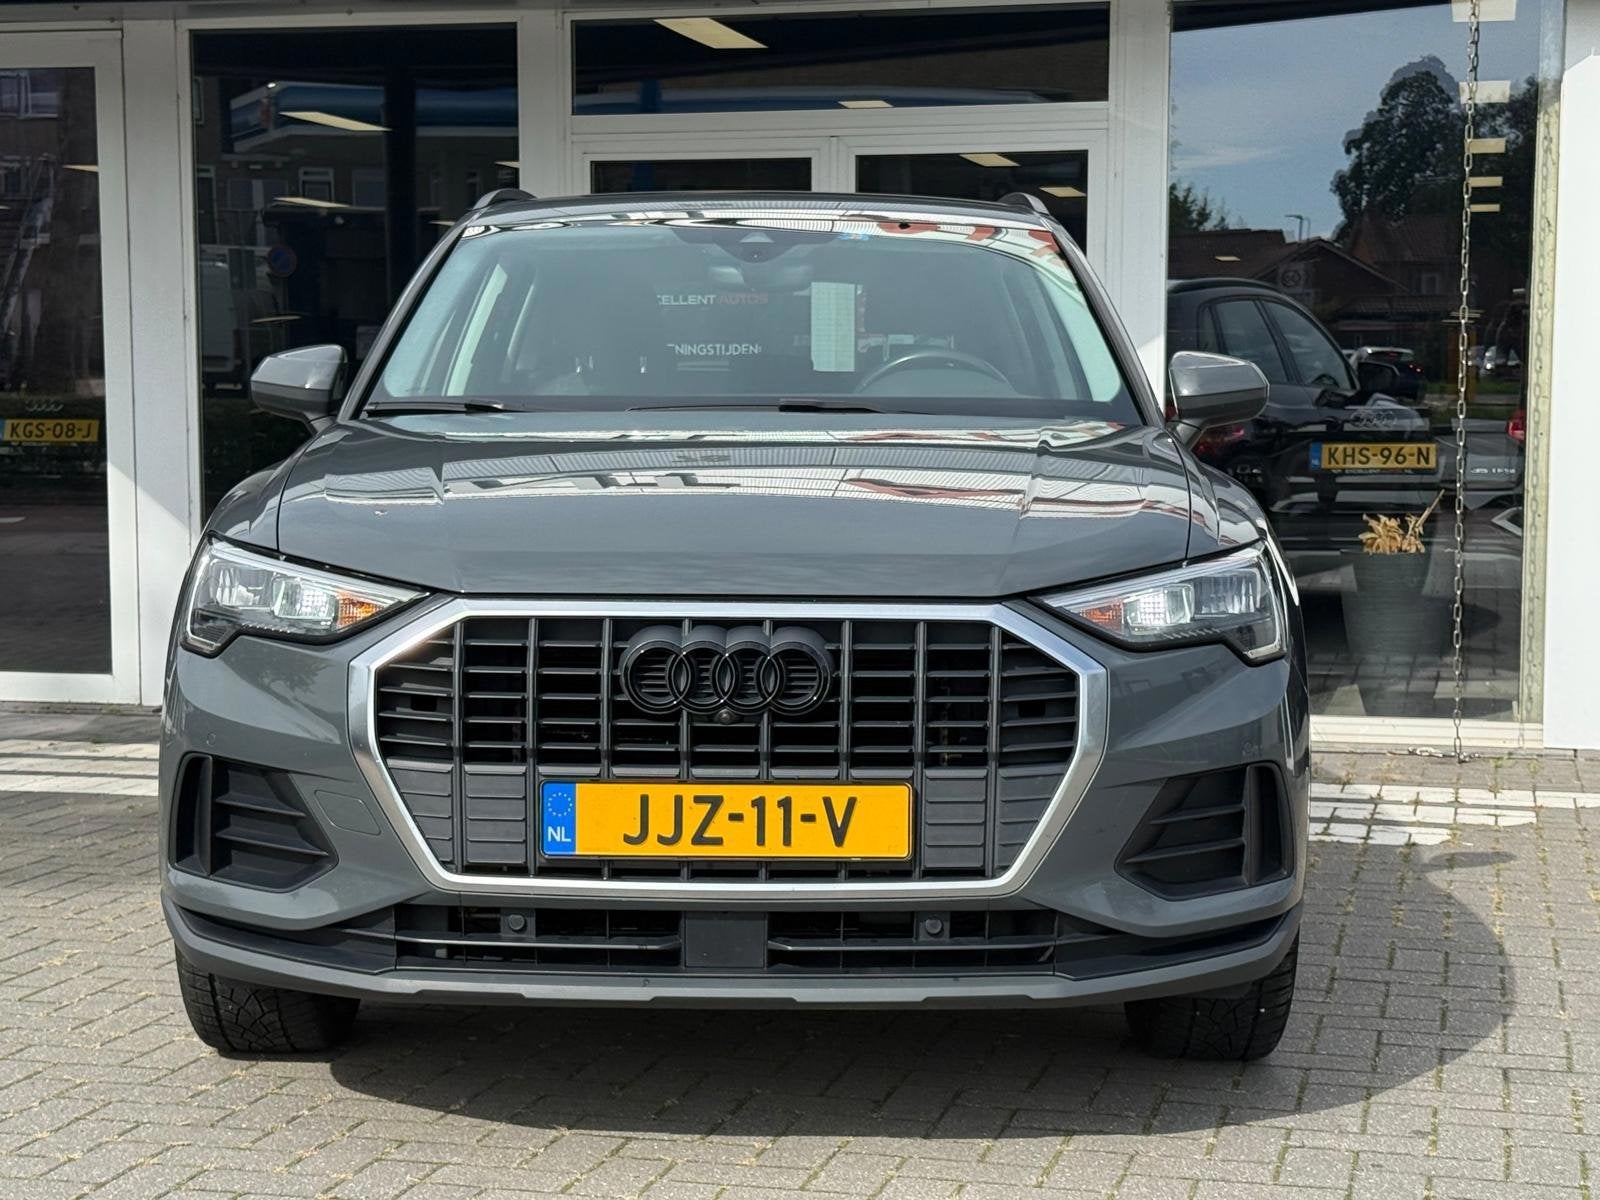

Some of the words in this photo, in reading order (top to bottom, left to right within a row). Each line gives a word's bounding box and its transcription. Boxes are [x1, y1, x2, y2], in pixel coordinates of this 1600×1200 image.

[9, 422, 93, 439] KGS-08-J
[1327, 446, 1431, 466] KHS-96-N
[547, 825, 572, 843] NL
[622, 793, 858, 848] JJZ-11-V
